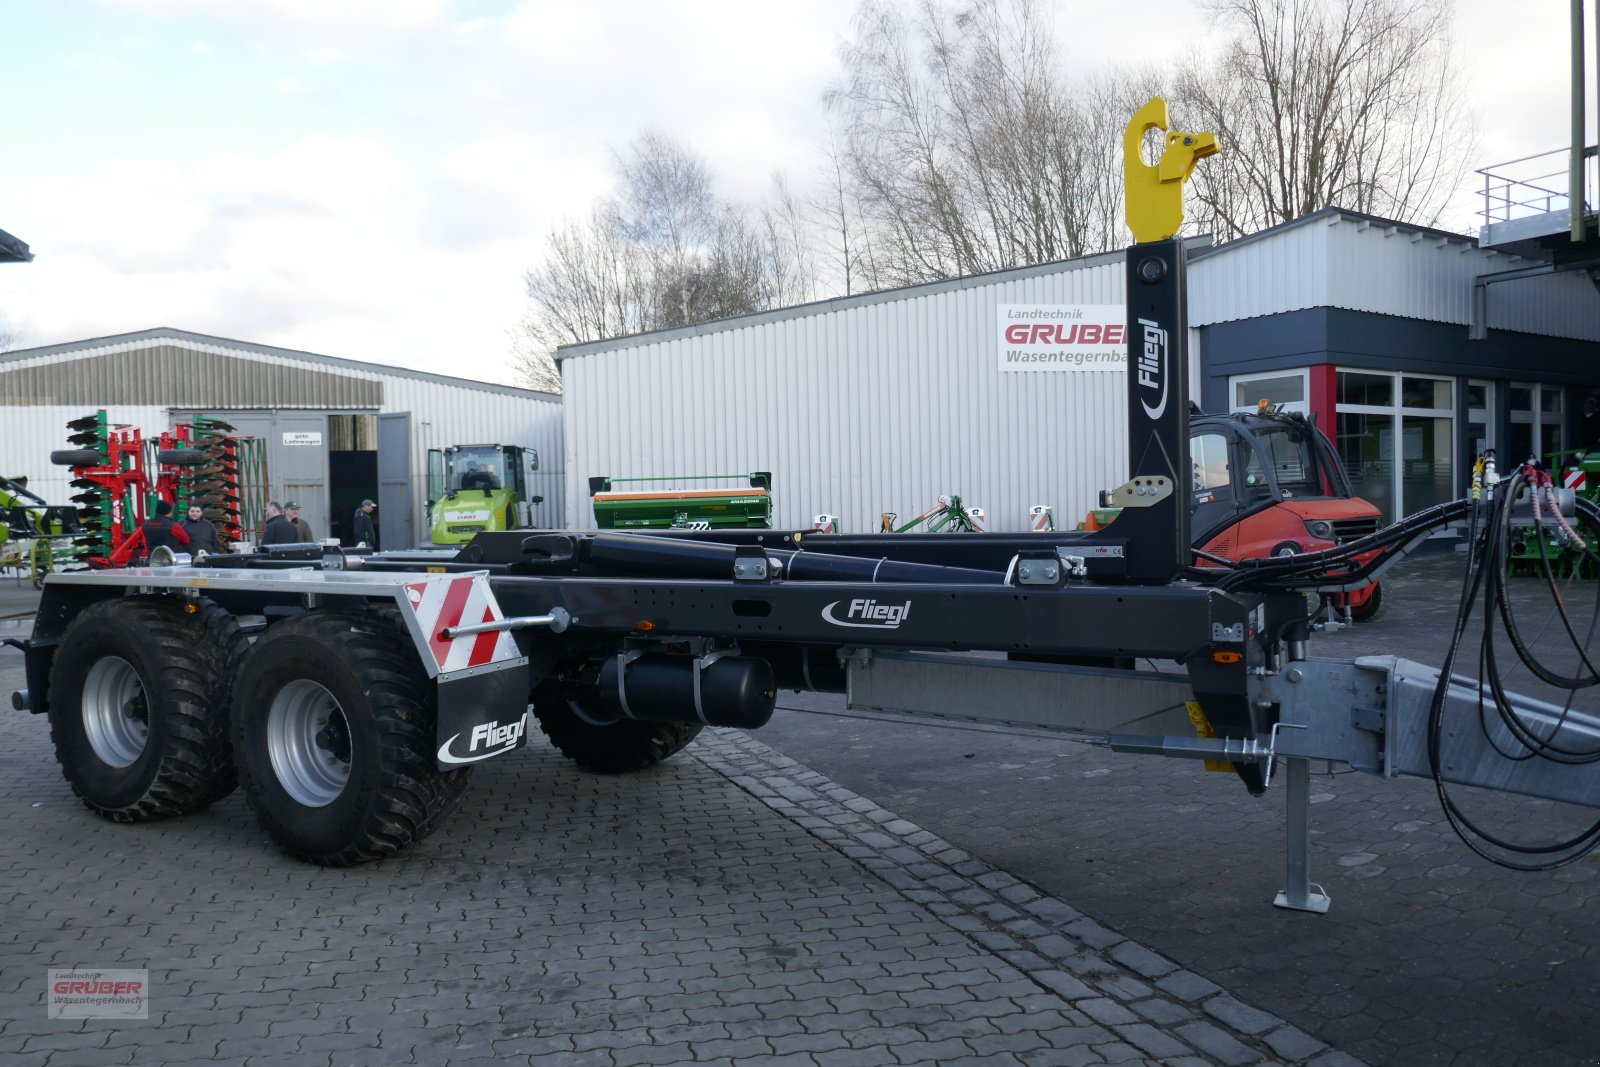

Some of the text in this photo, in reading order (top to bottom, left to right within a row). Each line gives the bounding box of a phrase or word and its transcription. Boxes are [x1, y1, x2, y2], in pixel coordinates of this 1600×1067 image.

[1007, 309, 1083, 319] Landtechnik
[1006, 350, 1128, 366] Wasentegernba
[1137, 317, 1164, 389] Fliegl
[847, 598, 912, 625] Fliegl
[469, 712, 528, 752] Fliegl
